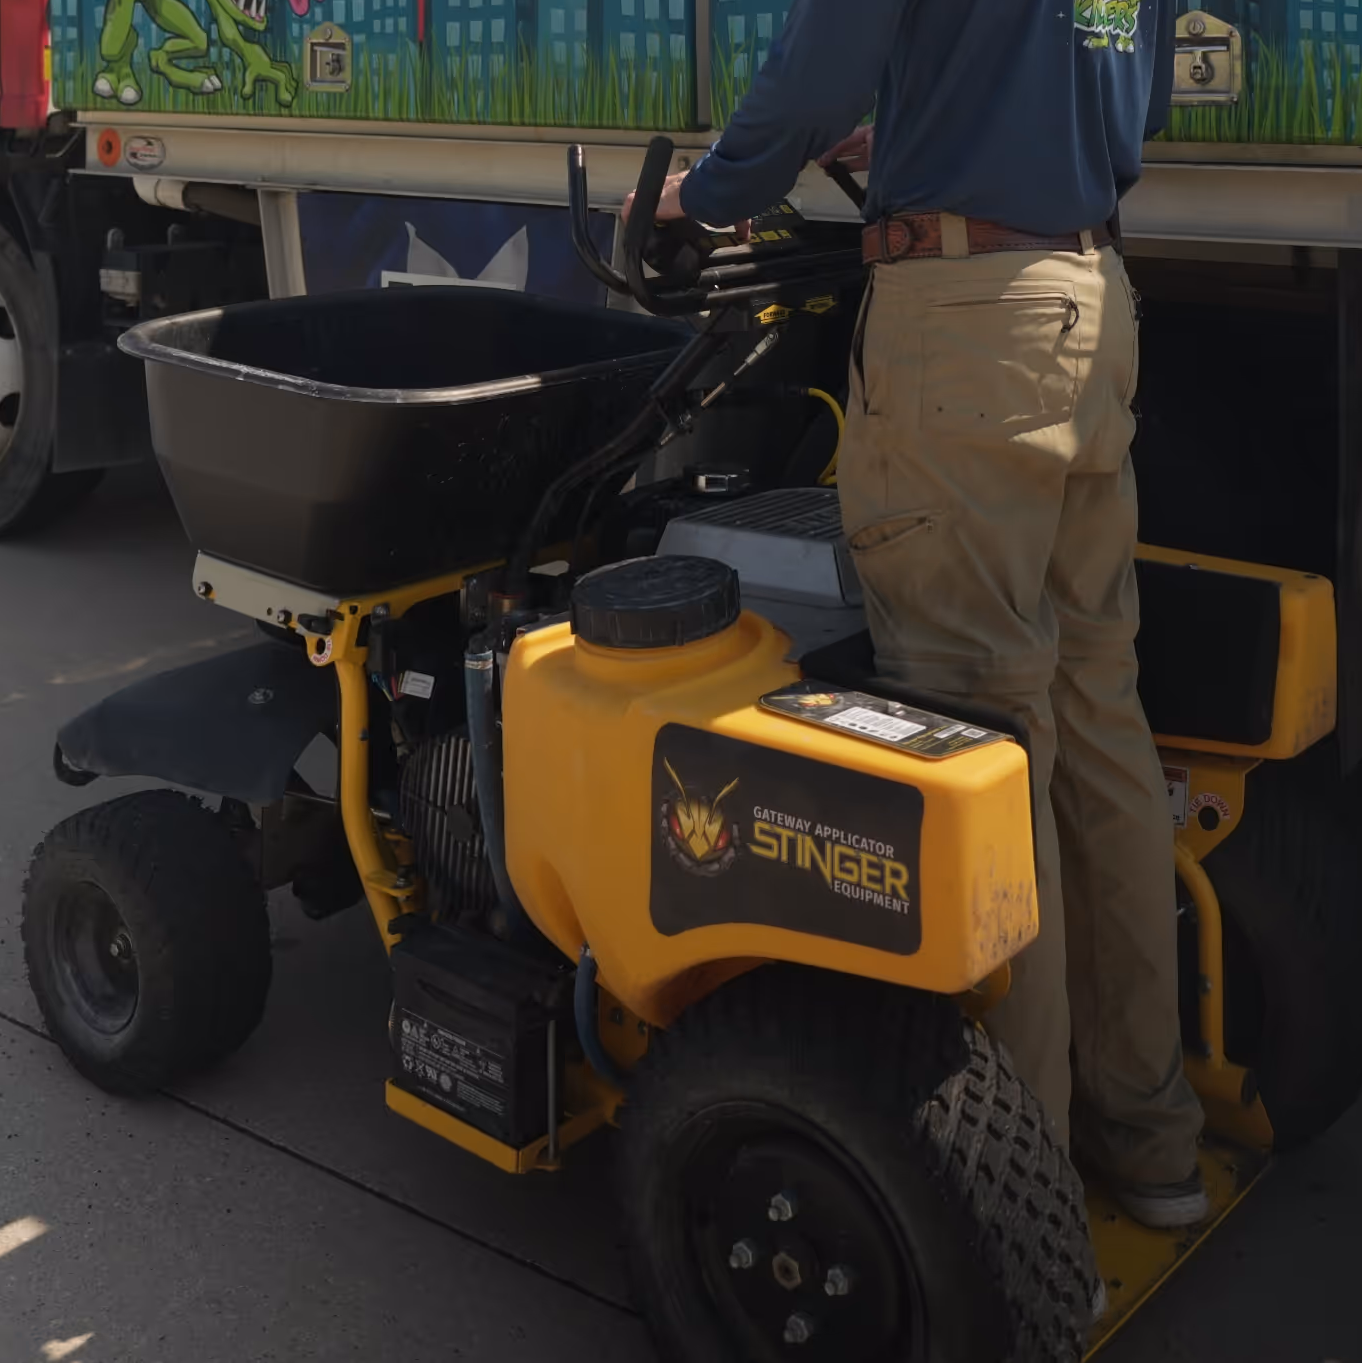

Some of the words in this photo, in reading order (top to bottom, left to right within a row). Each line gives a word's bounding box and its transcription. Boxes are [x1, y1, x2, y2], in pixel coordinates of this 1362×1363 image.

[753, 805, 812, 833] GATEWAY
[815, 823, 895, 859] APPLICATOR
[748, 819, 910, 901] STINGER
[834, 880, 910, 915] EQUIPMENT
